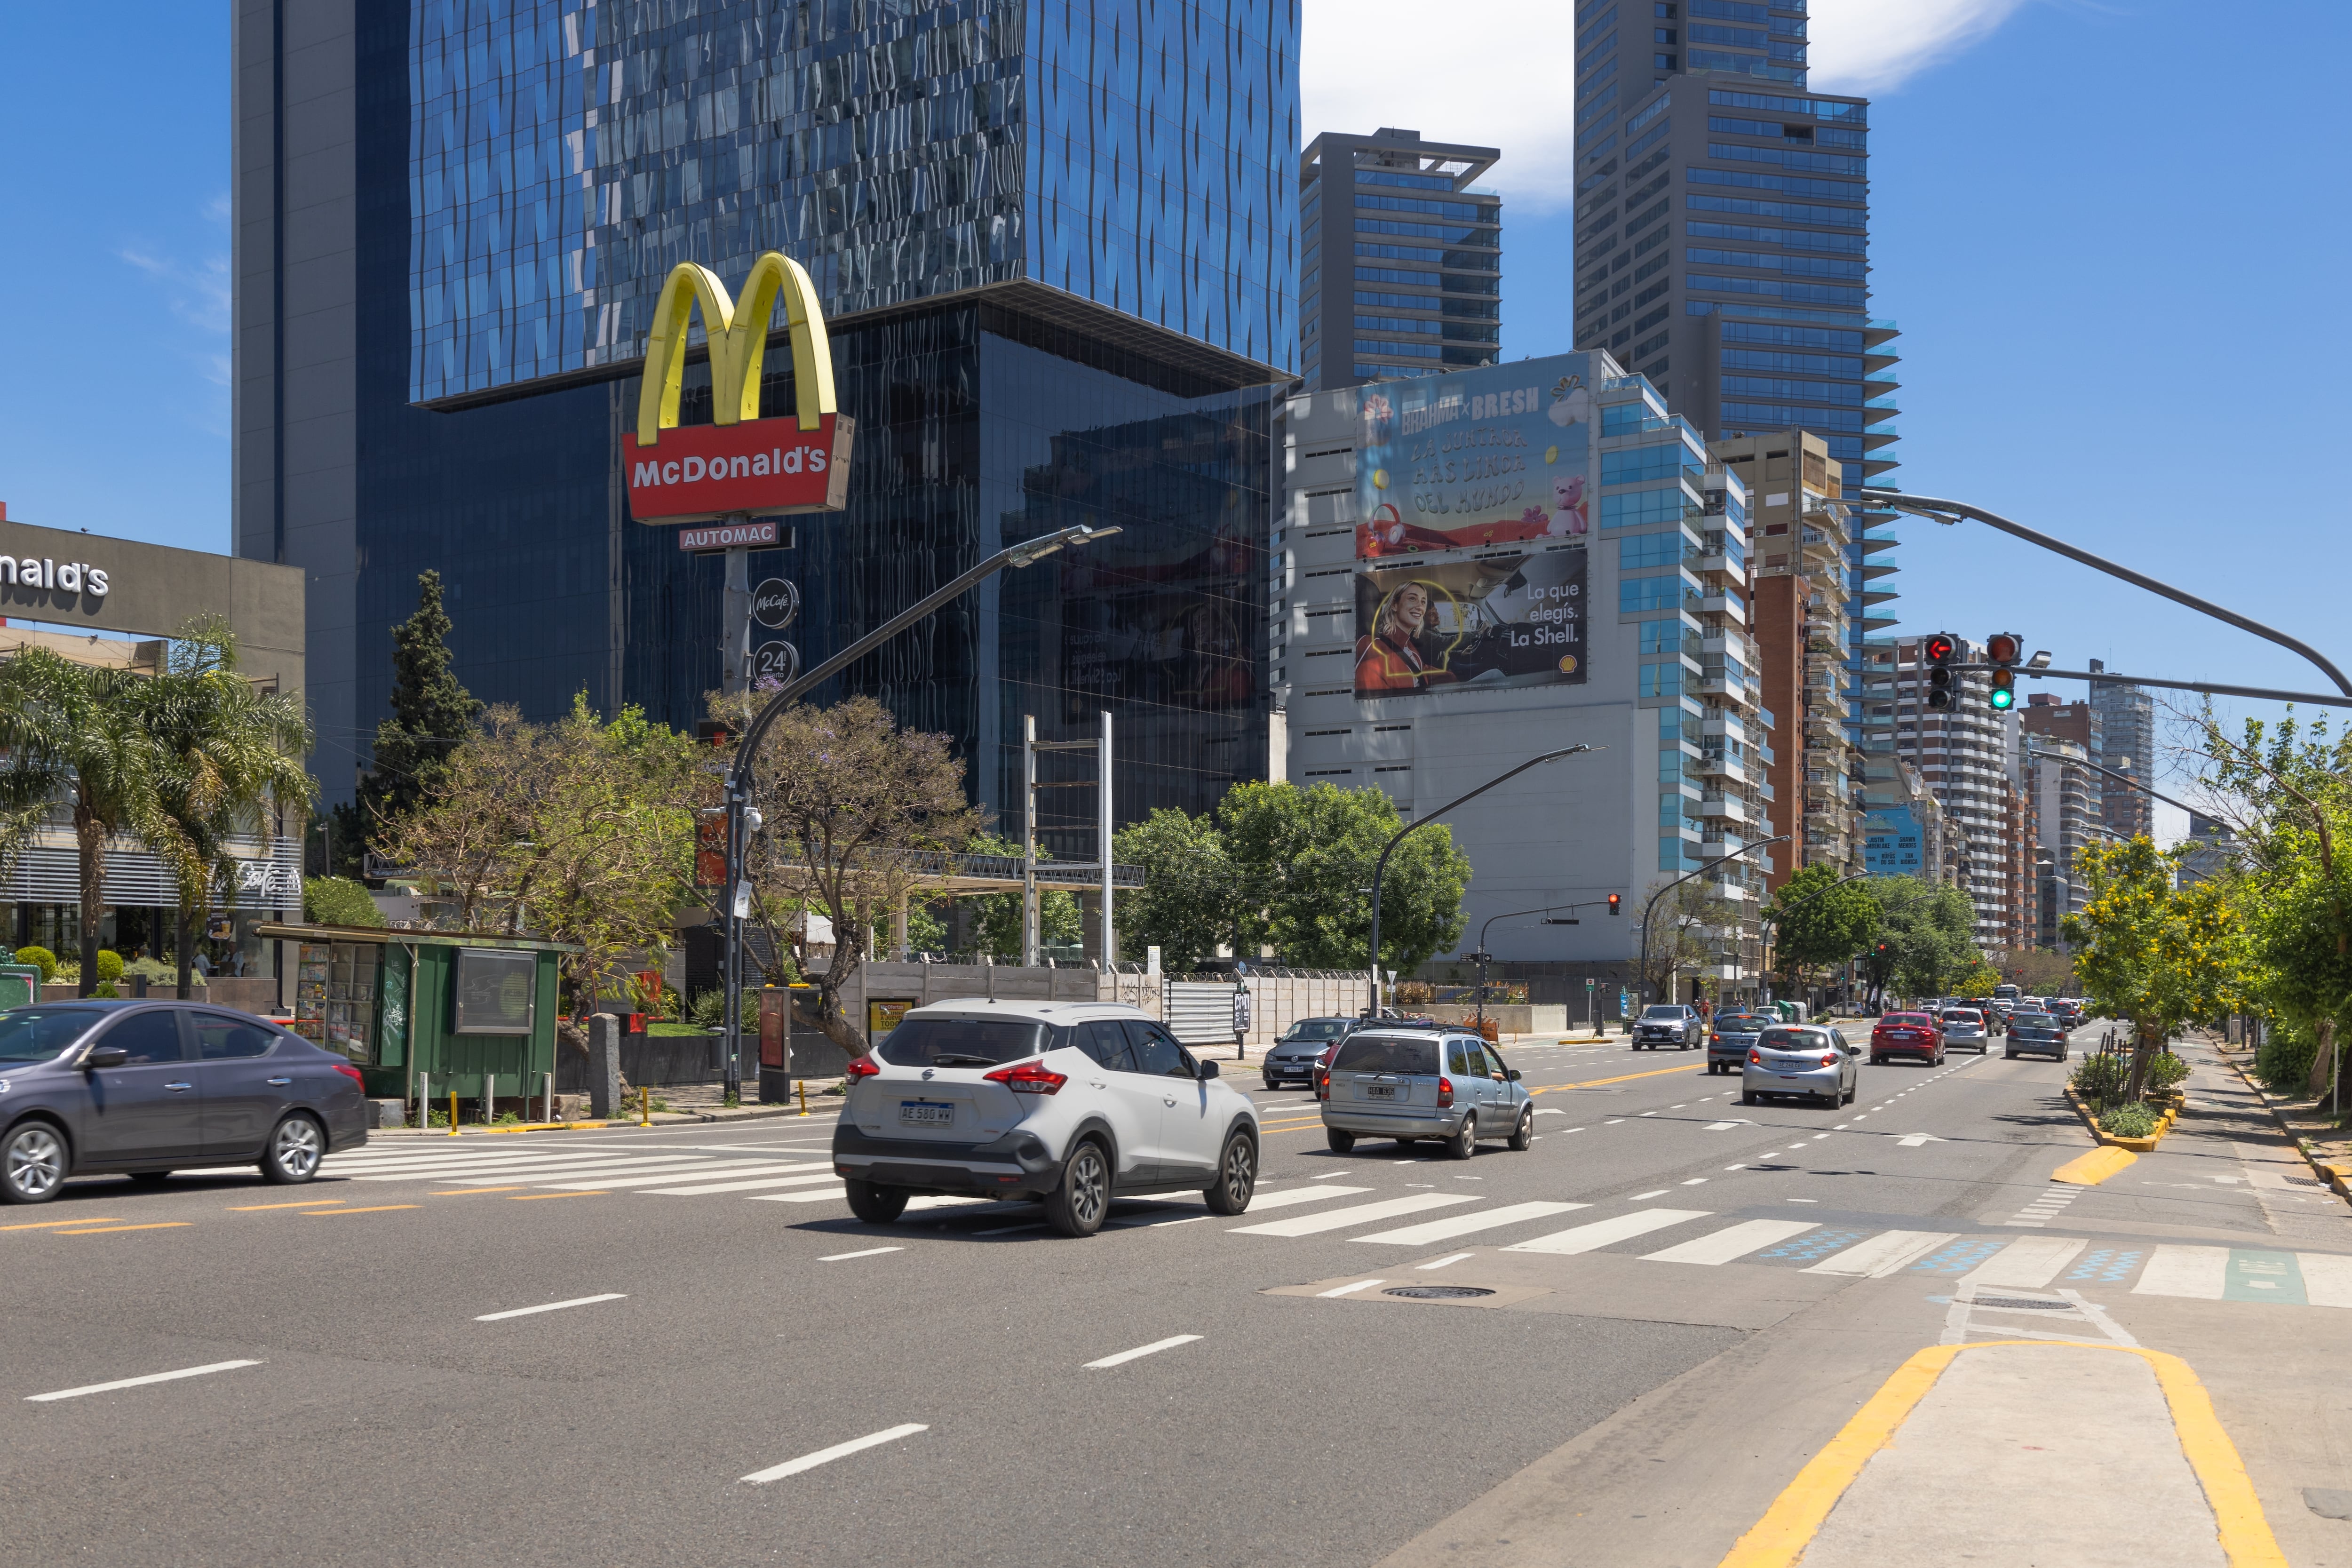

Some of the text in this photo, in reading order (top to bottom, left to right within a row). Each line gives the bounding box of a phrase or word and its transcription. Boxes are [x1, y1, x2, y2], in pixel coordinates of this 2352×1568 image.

[1402, 397, 1459, 436] BRAHMA
[1472, 387, 1539, 421] BRESH
[1411, 427, 1528, 462] LA JUNTADA
[633, 446, 826, 488] McDonald's
[1463, 454, 1526, 482] LINDA
[1414, 479, 1524, 514] DEL MUNDO
[684, 525, 773, 547] AUTOMAC
[0, 555, 109, 597] nald's
[756, 594, 789, 611] McCafé
[1527, 583, 1579, 603] La que
[1530, 602, 1578, 625] elegís.
[1511, 623, 1579, 647] La Shell.
[761, 651, 786, 672] 24
[902, 1108, 914, 1118] AE
[917, 1108, 935, 1119] 580
